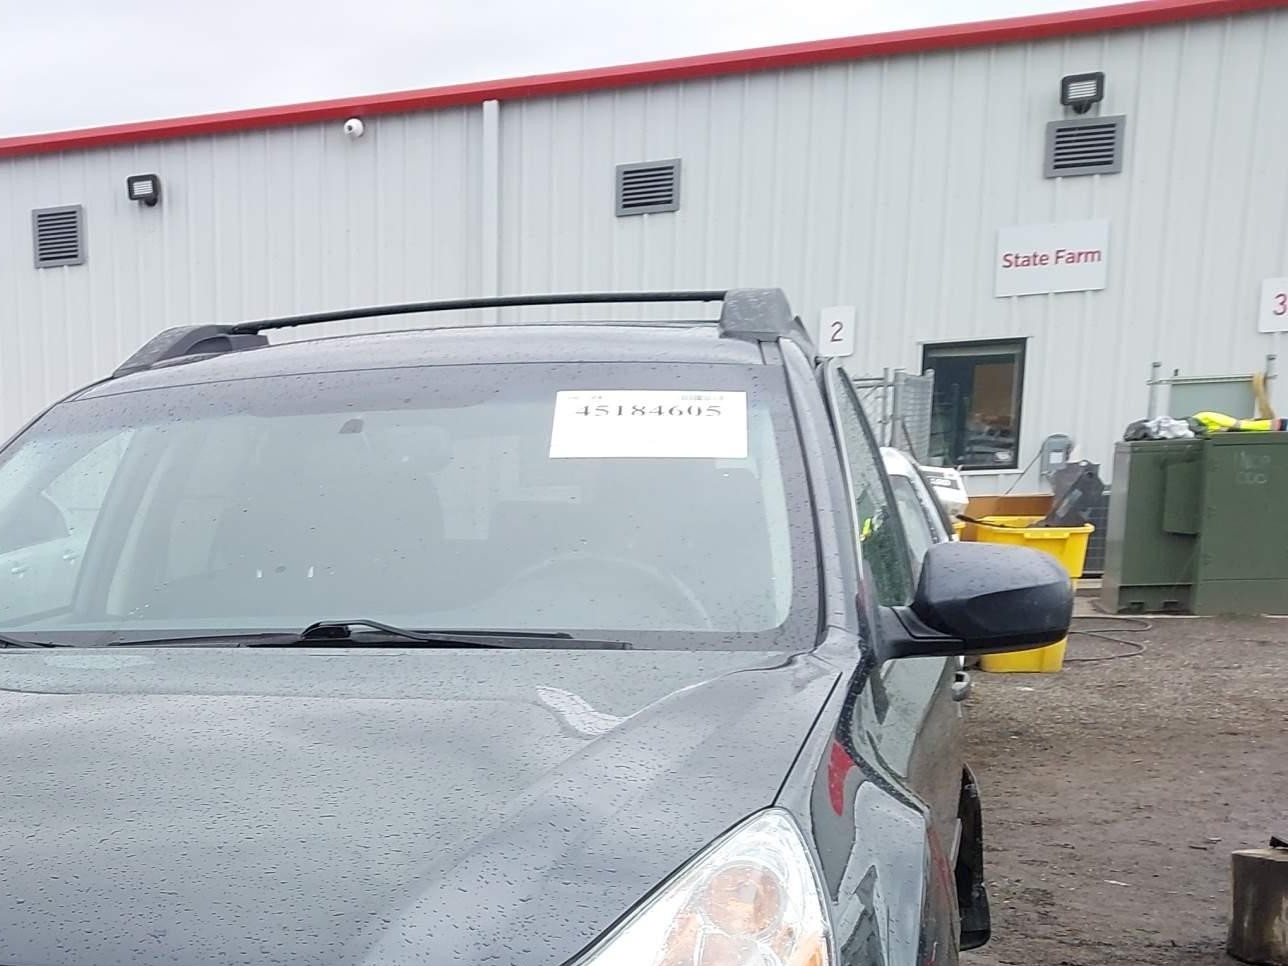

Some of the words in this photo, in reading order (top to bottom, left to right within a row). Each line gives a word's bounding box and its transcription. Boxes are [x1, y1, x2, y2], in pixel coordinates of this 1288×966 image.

[1002, 252, 1049, 269] State
[1054, 248, 1102, 265] Farm
[1272, 293, 1287, 316] 3
[830, 321, 844, 342] 2
[575, 404, 722, 417] 45184605
